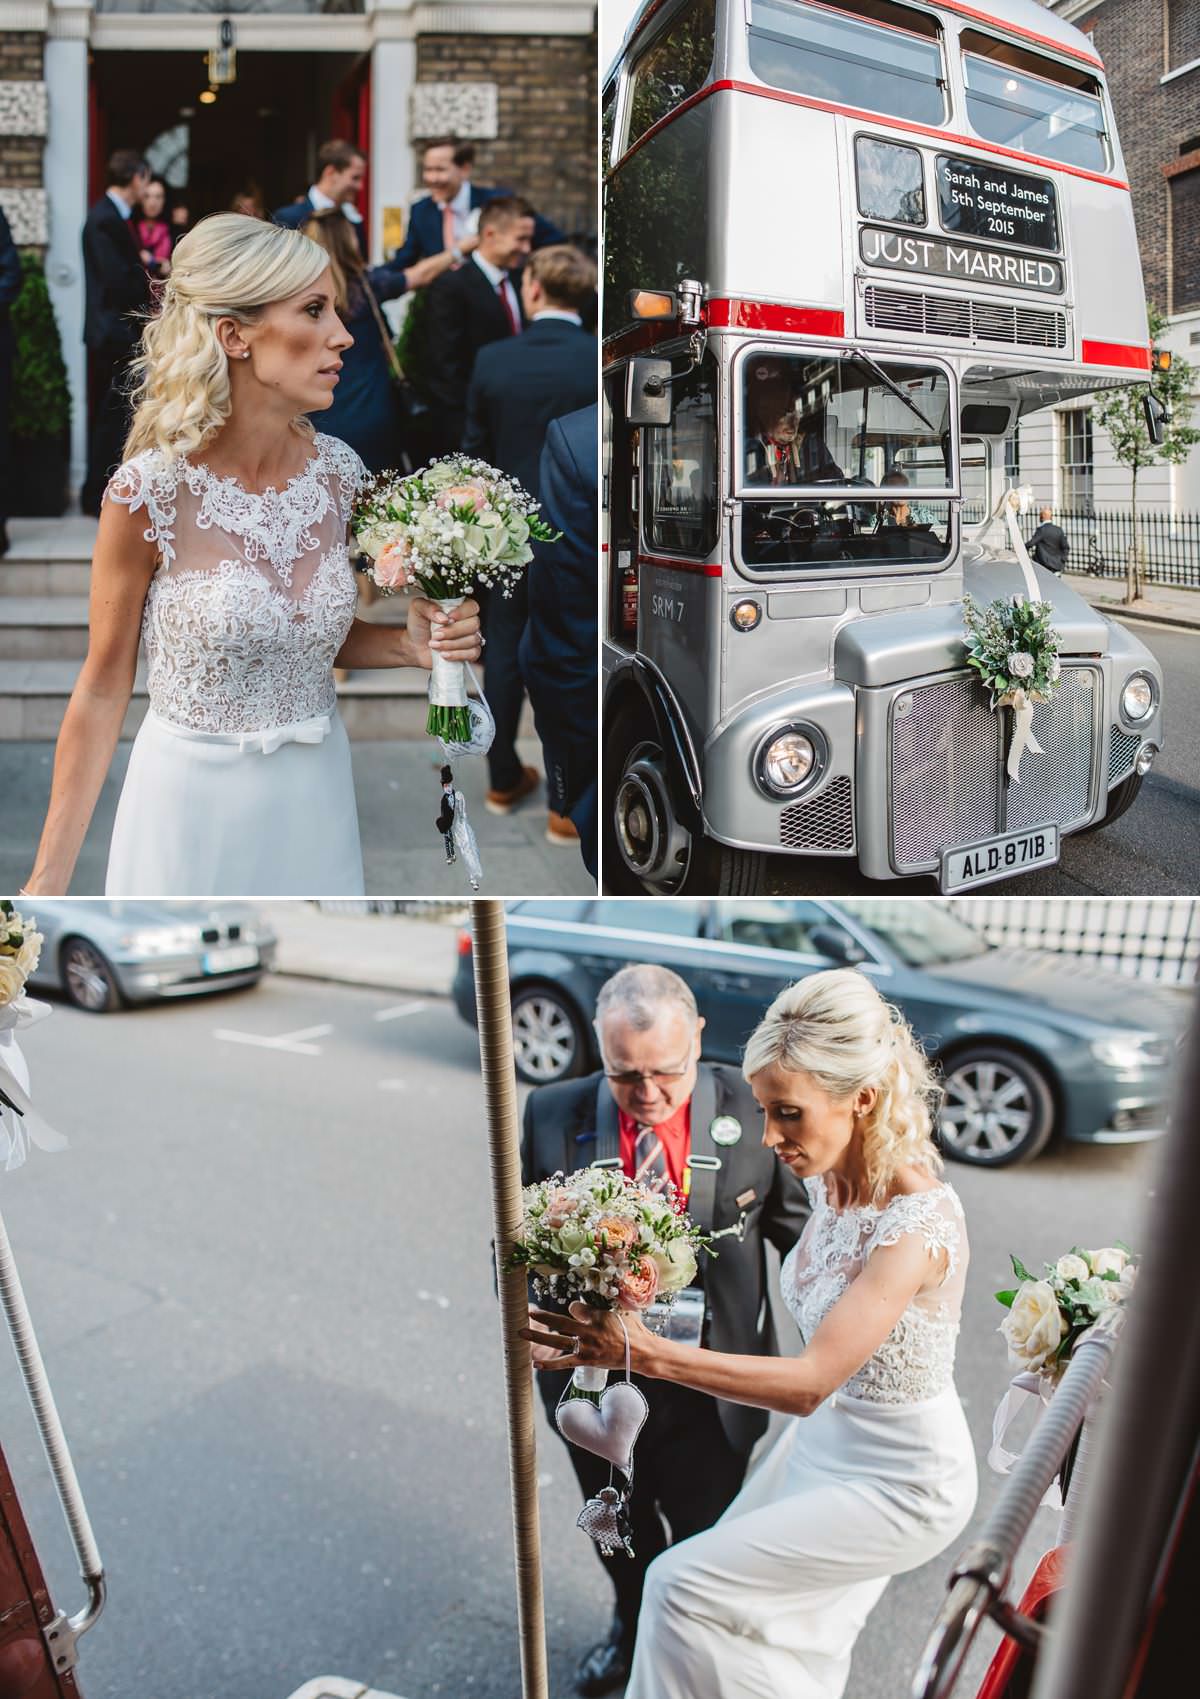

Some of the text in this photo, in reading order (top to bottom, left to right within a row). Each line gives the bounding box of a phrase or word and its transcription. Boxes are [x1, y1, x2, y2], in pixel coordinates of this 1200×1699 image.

[944, 167, 1049, 205] Sarah and James
[951, 190, 1046, 222] 5th September
[987, 218, 1015, 236] 2015
[866, 233, 1056, 287] JUST MARRIED
[652, 594, 674, 620] SRM
[677, 601, 685, 622] 7
